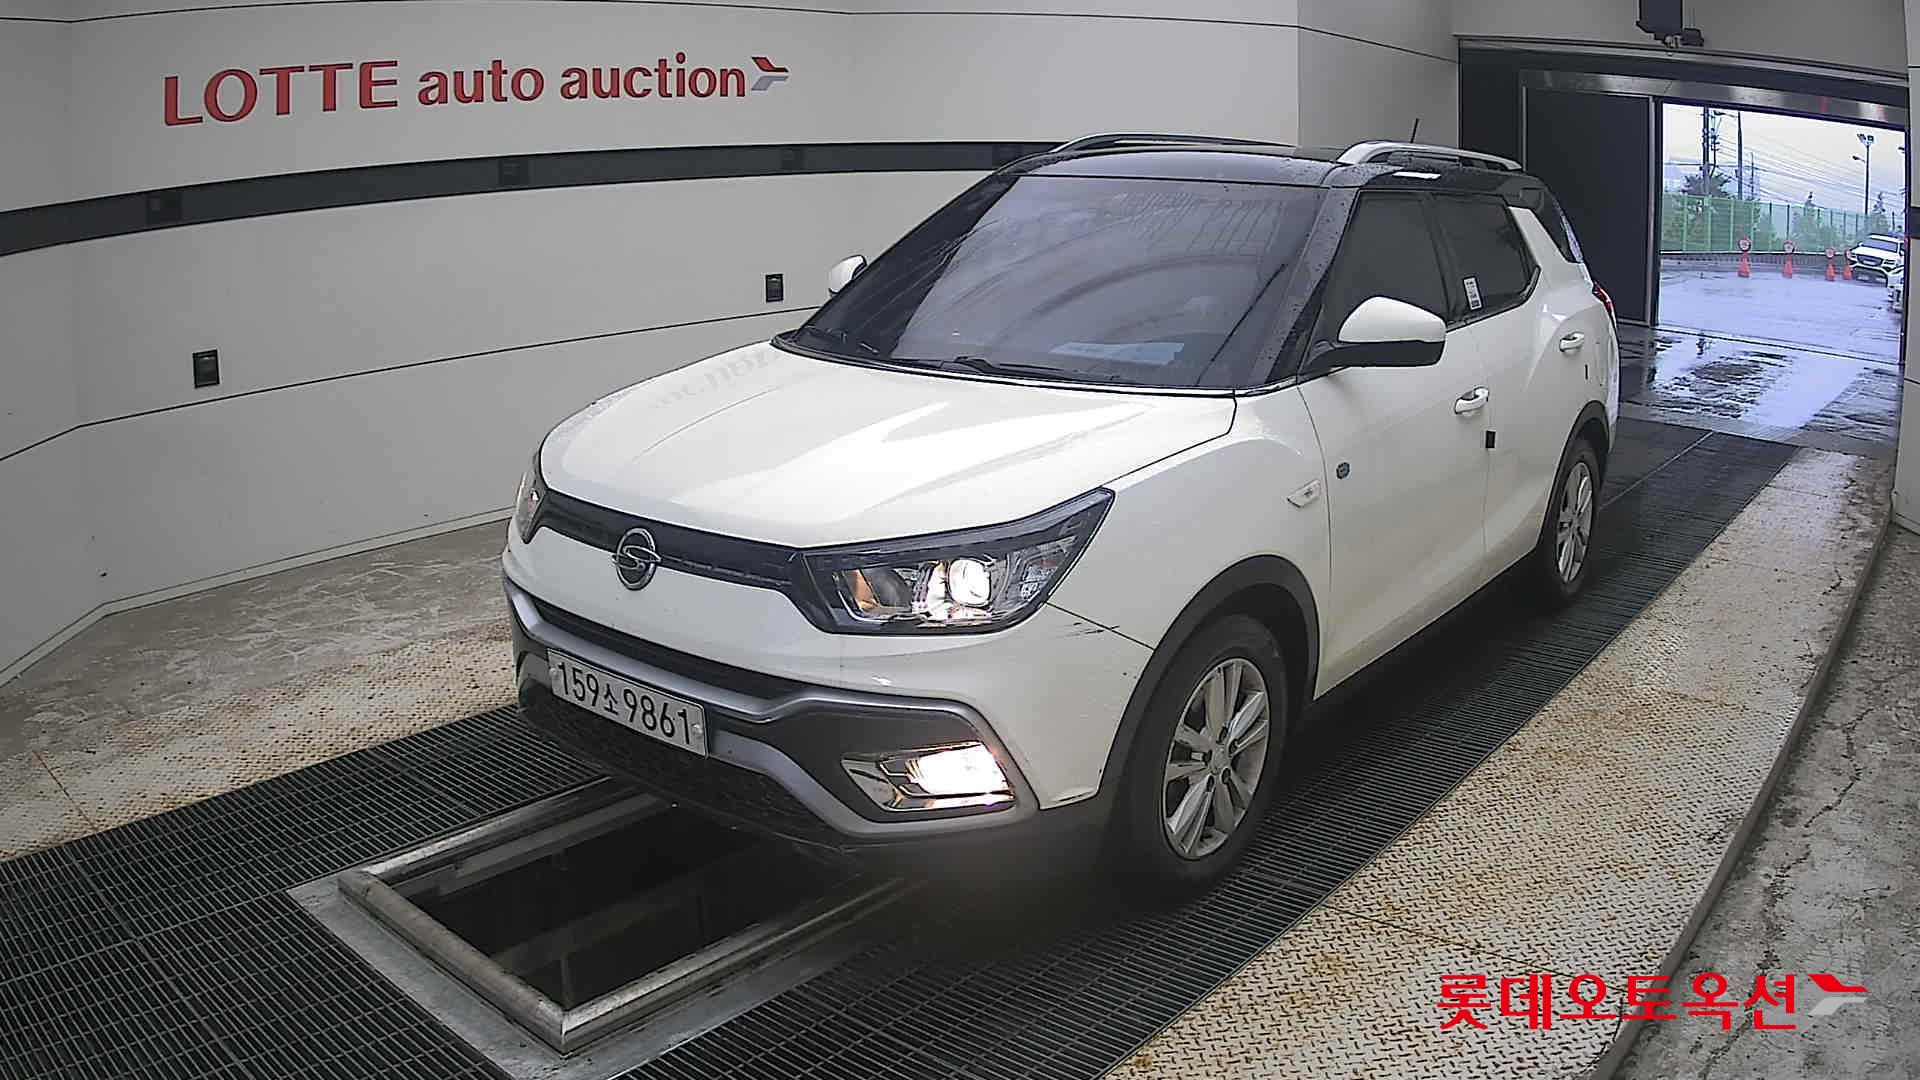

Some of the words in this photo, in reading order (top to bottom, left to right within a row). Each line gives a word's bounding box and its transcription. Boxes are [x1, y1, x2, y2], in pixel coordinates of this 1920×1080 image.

[163, 60, 398, 126] LOTTE
[417, 60, 545, 106] auto
[559, 52, 746, 99] auction
[557, 661, 691, 745] 159소9861
